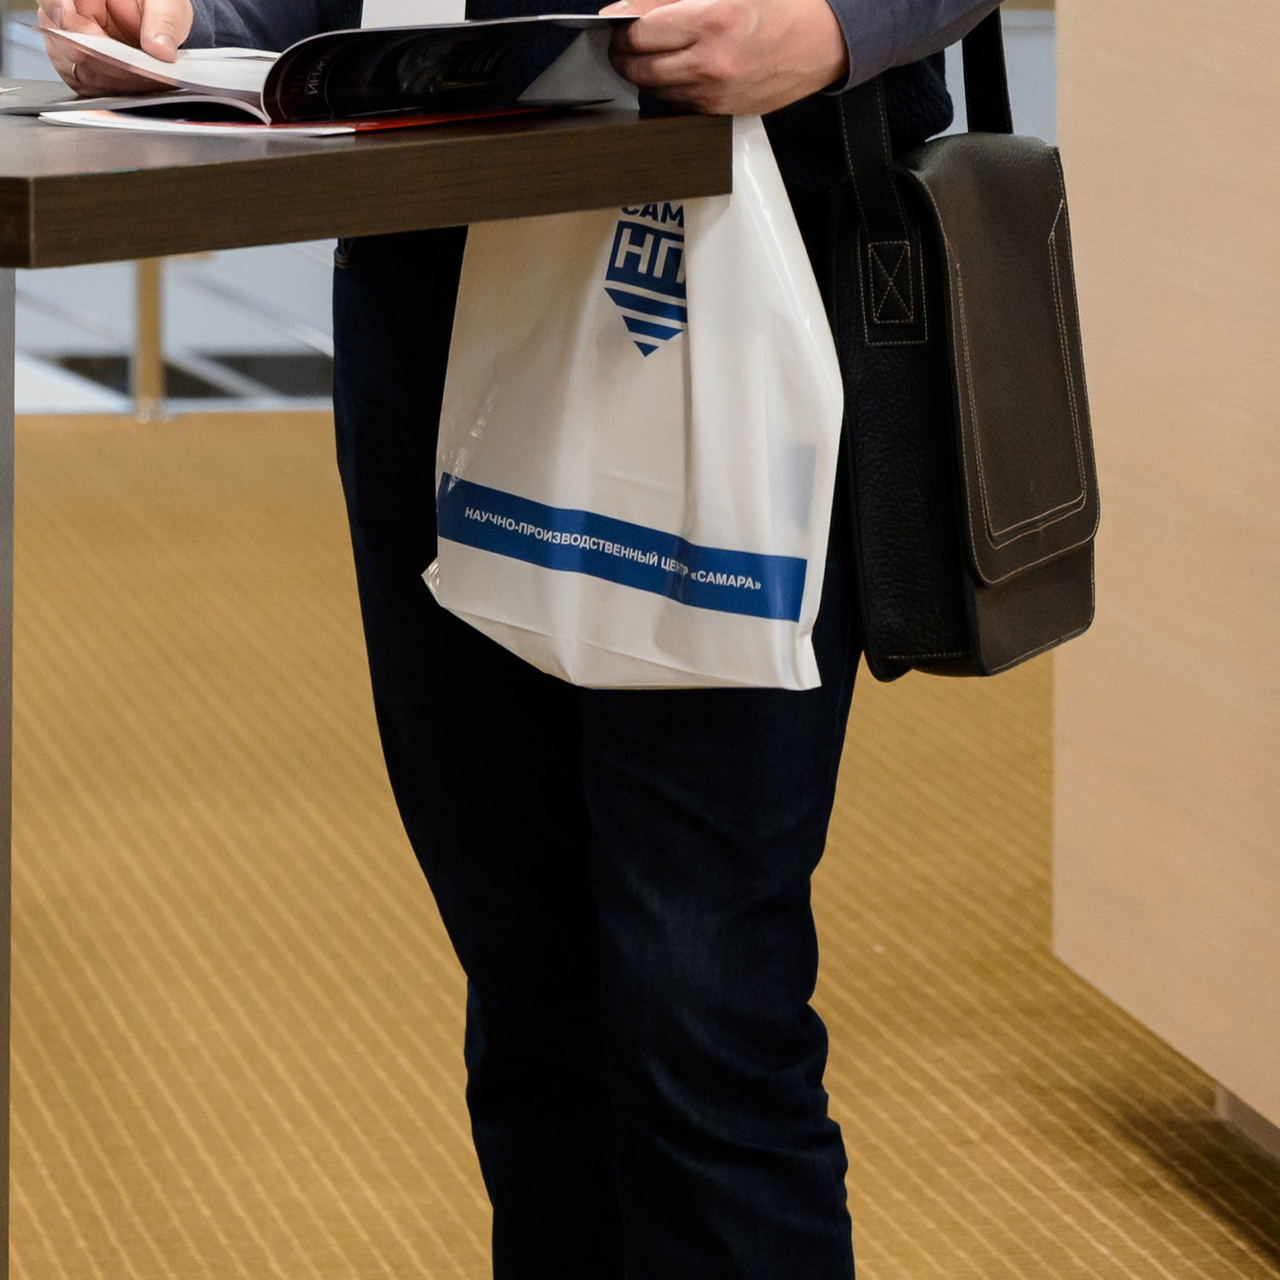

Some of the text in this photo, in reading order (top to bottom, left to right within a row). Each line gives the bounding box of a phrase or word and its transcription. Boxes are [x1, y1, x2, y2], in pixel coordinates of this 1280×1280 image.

[464, 506, 762, 591] НАУЧНО-ПРОИЗВОДСТВЕННЫЙ ЦЕНТР «САМАРА»
